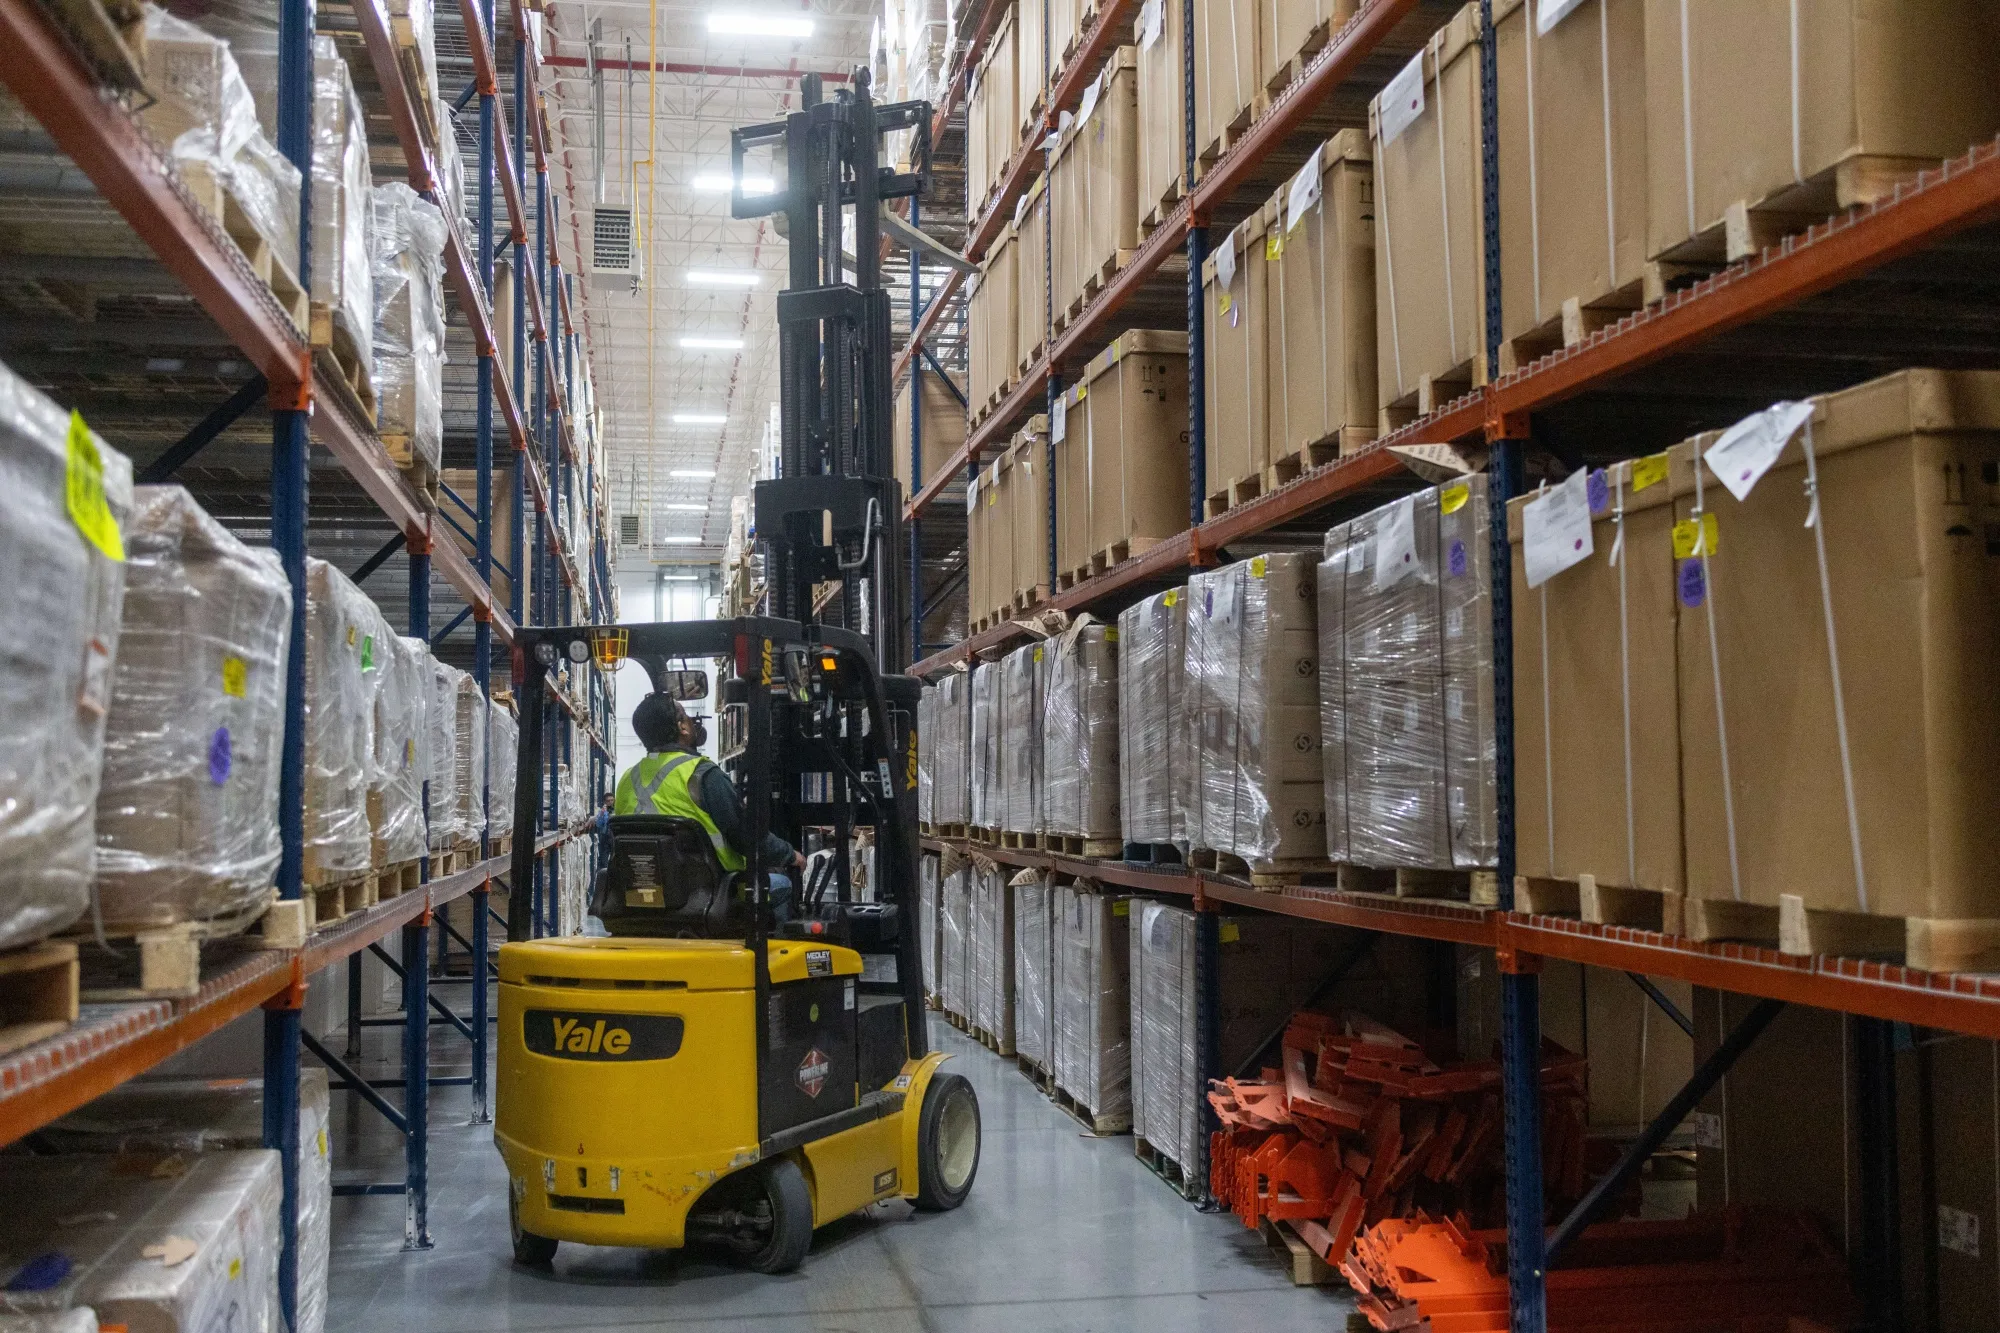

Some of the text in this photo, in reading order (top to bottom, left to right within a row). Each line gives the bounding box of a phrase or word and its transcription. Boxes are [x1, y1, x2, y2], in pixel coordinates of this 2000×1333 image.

[761, 638, 773, 685] Yale
[906, 729, 918, 791] Yale
[806, 950, 830, 960] MEDLEY
[552, 1017, 632, 1055] Yale
